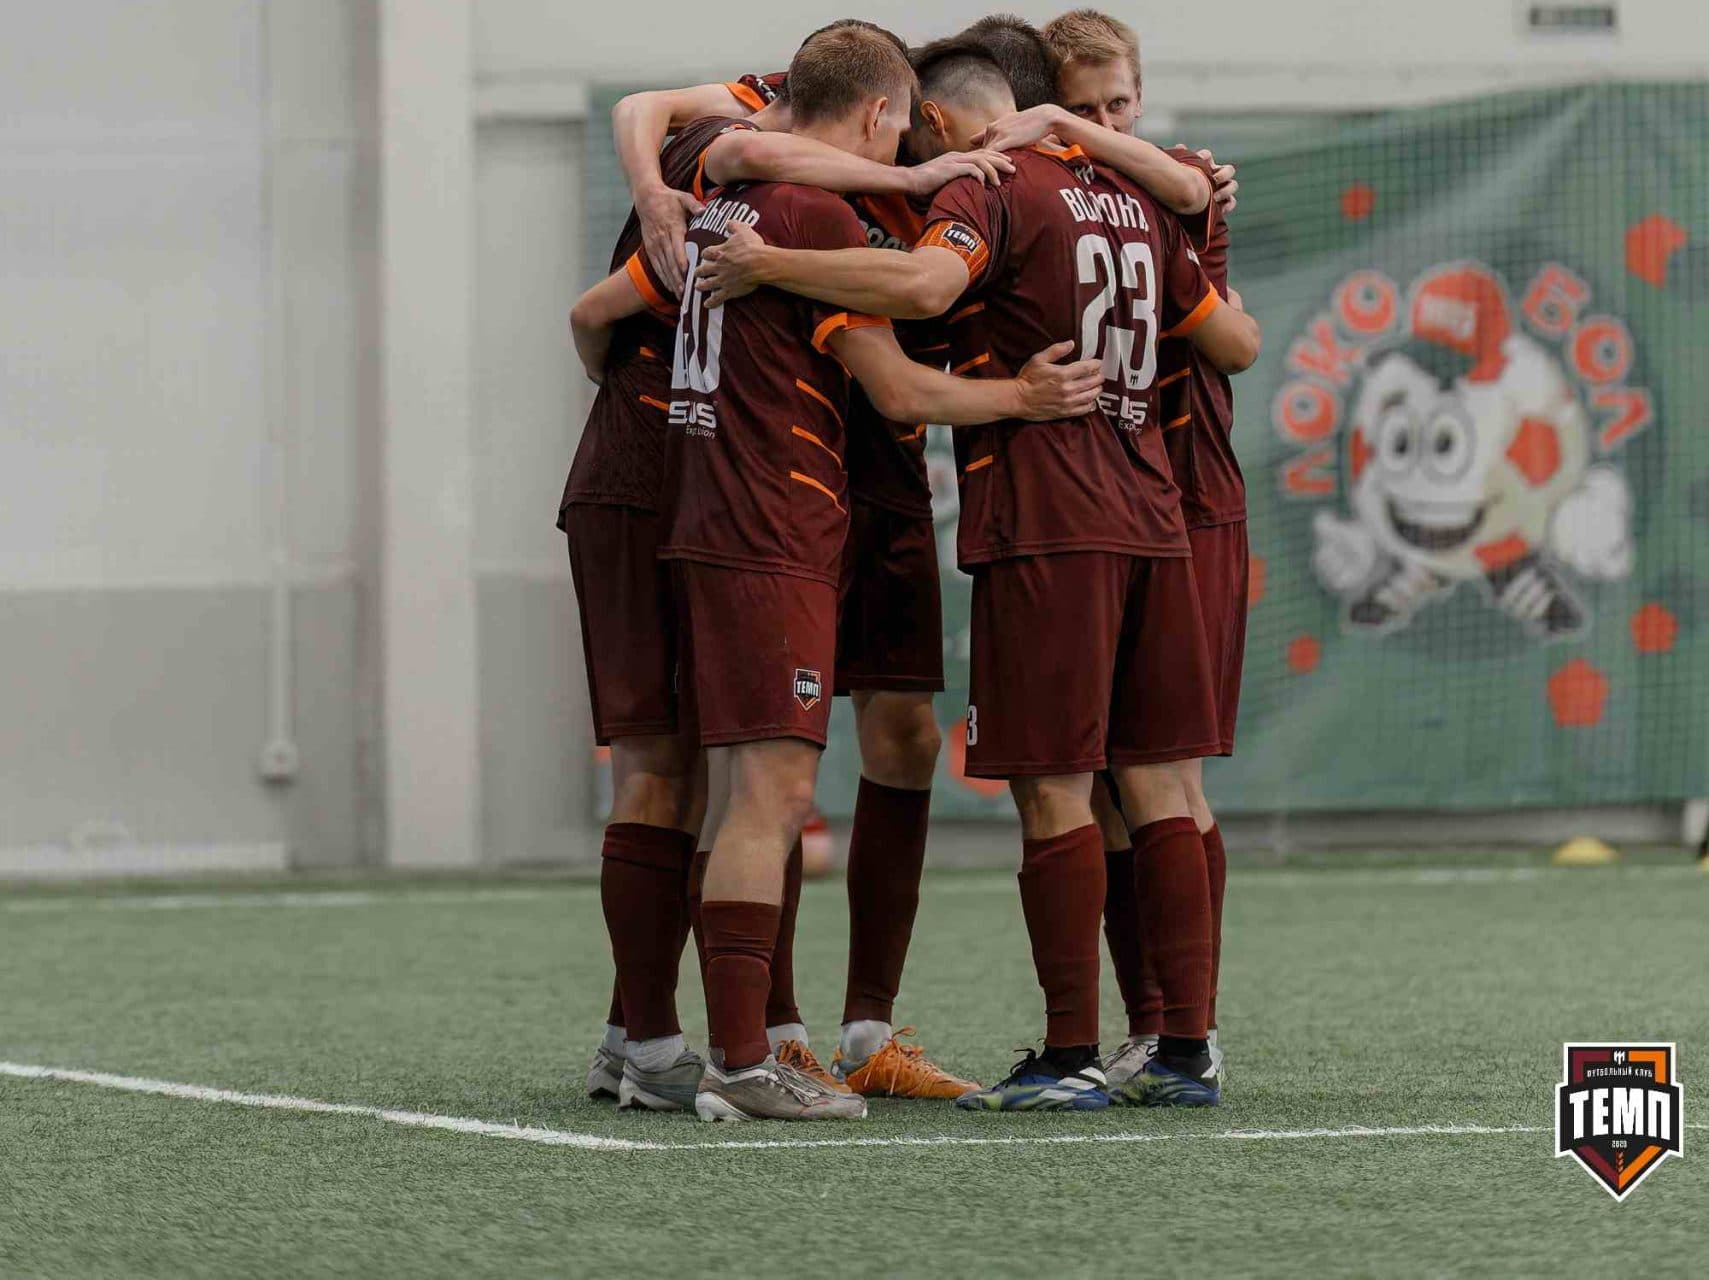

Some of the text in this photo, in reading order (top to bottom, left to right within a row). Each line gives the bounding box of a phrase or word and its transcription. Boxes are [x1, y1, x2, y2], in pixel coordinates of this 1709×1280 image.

[946, 229, 976, 250] ТЕМП
[1076, 234, 1158, 389] 23
[796, 680, 819, 697] ТЕМП
[967, 705, 978, 746] 3
